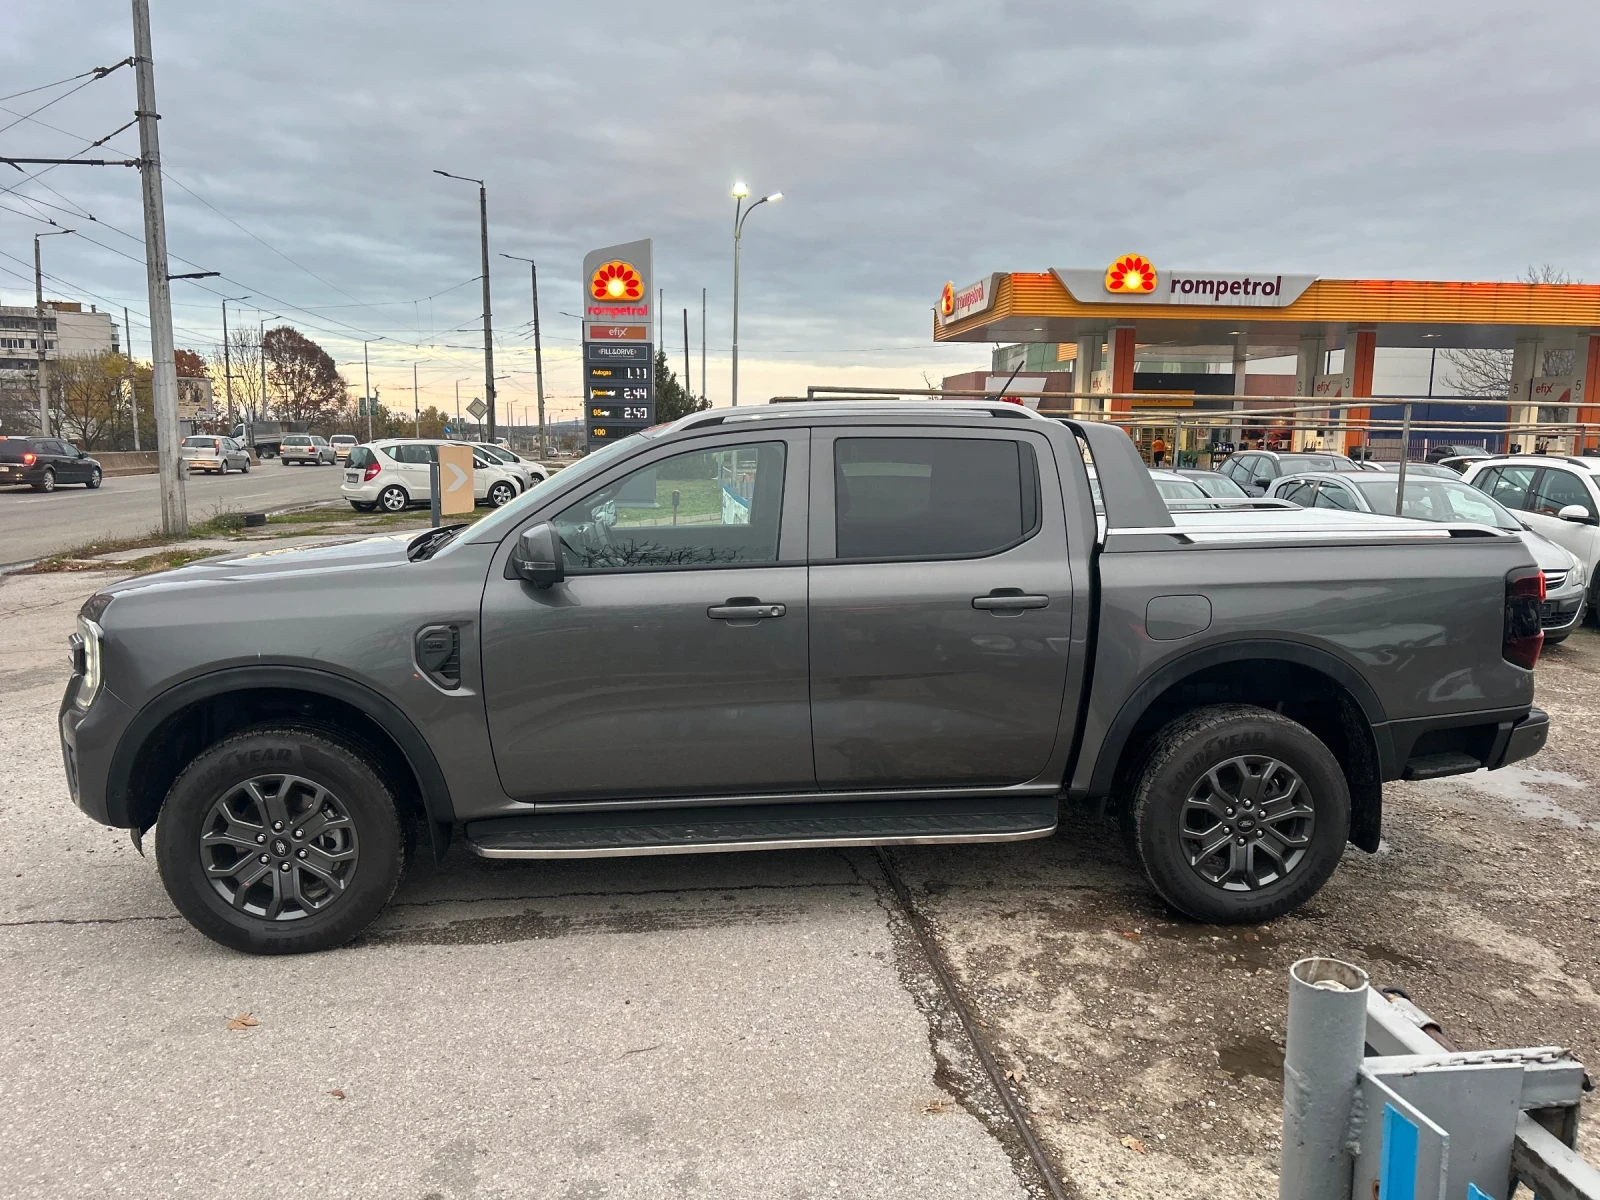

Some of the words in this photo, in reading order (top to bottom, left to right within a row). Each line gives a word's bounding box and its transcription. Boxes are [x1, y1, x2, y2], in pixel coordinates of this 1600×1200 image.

[1170, 275, 1282, 302] rompetrol
[588, 304, 647, 318] rompetrol
[608, 327, 628, 338] efix
[1316, 381, 1332, 395] efix
[1345, 378, 1350, 389] 3
[1513, 384, 1519, 394] 5
[1575, 380, 1582, 391] 5
[623, 388, 647, 399] 2.44
[1535, 383, 1555, 396] efix
